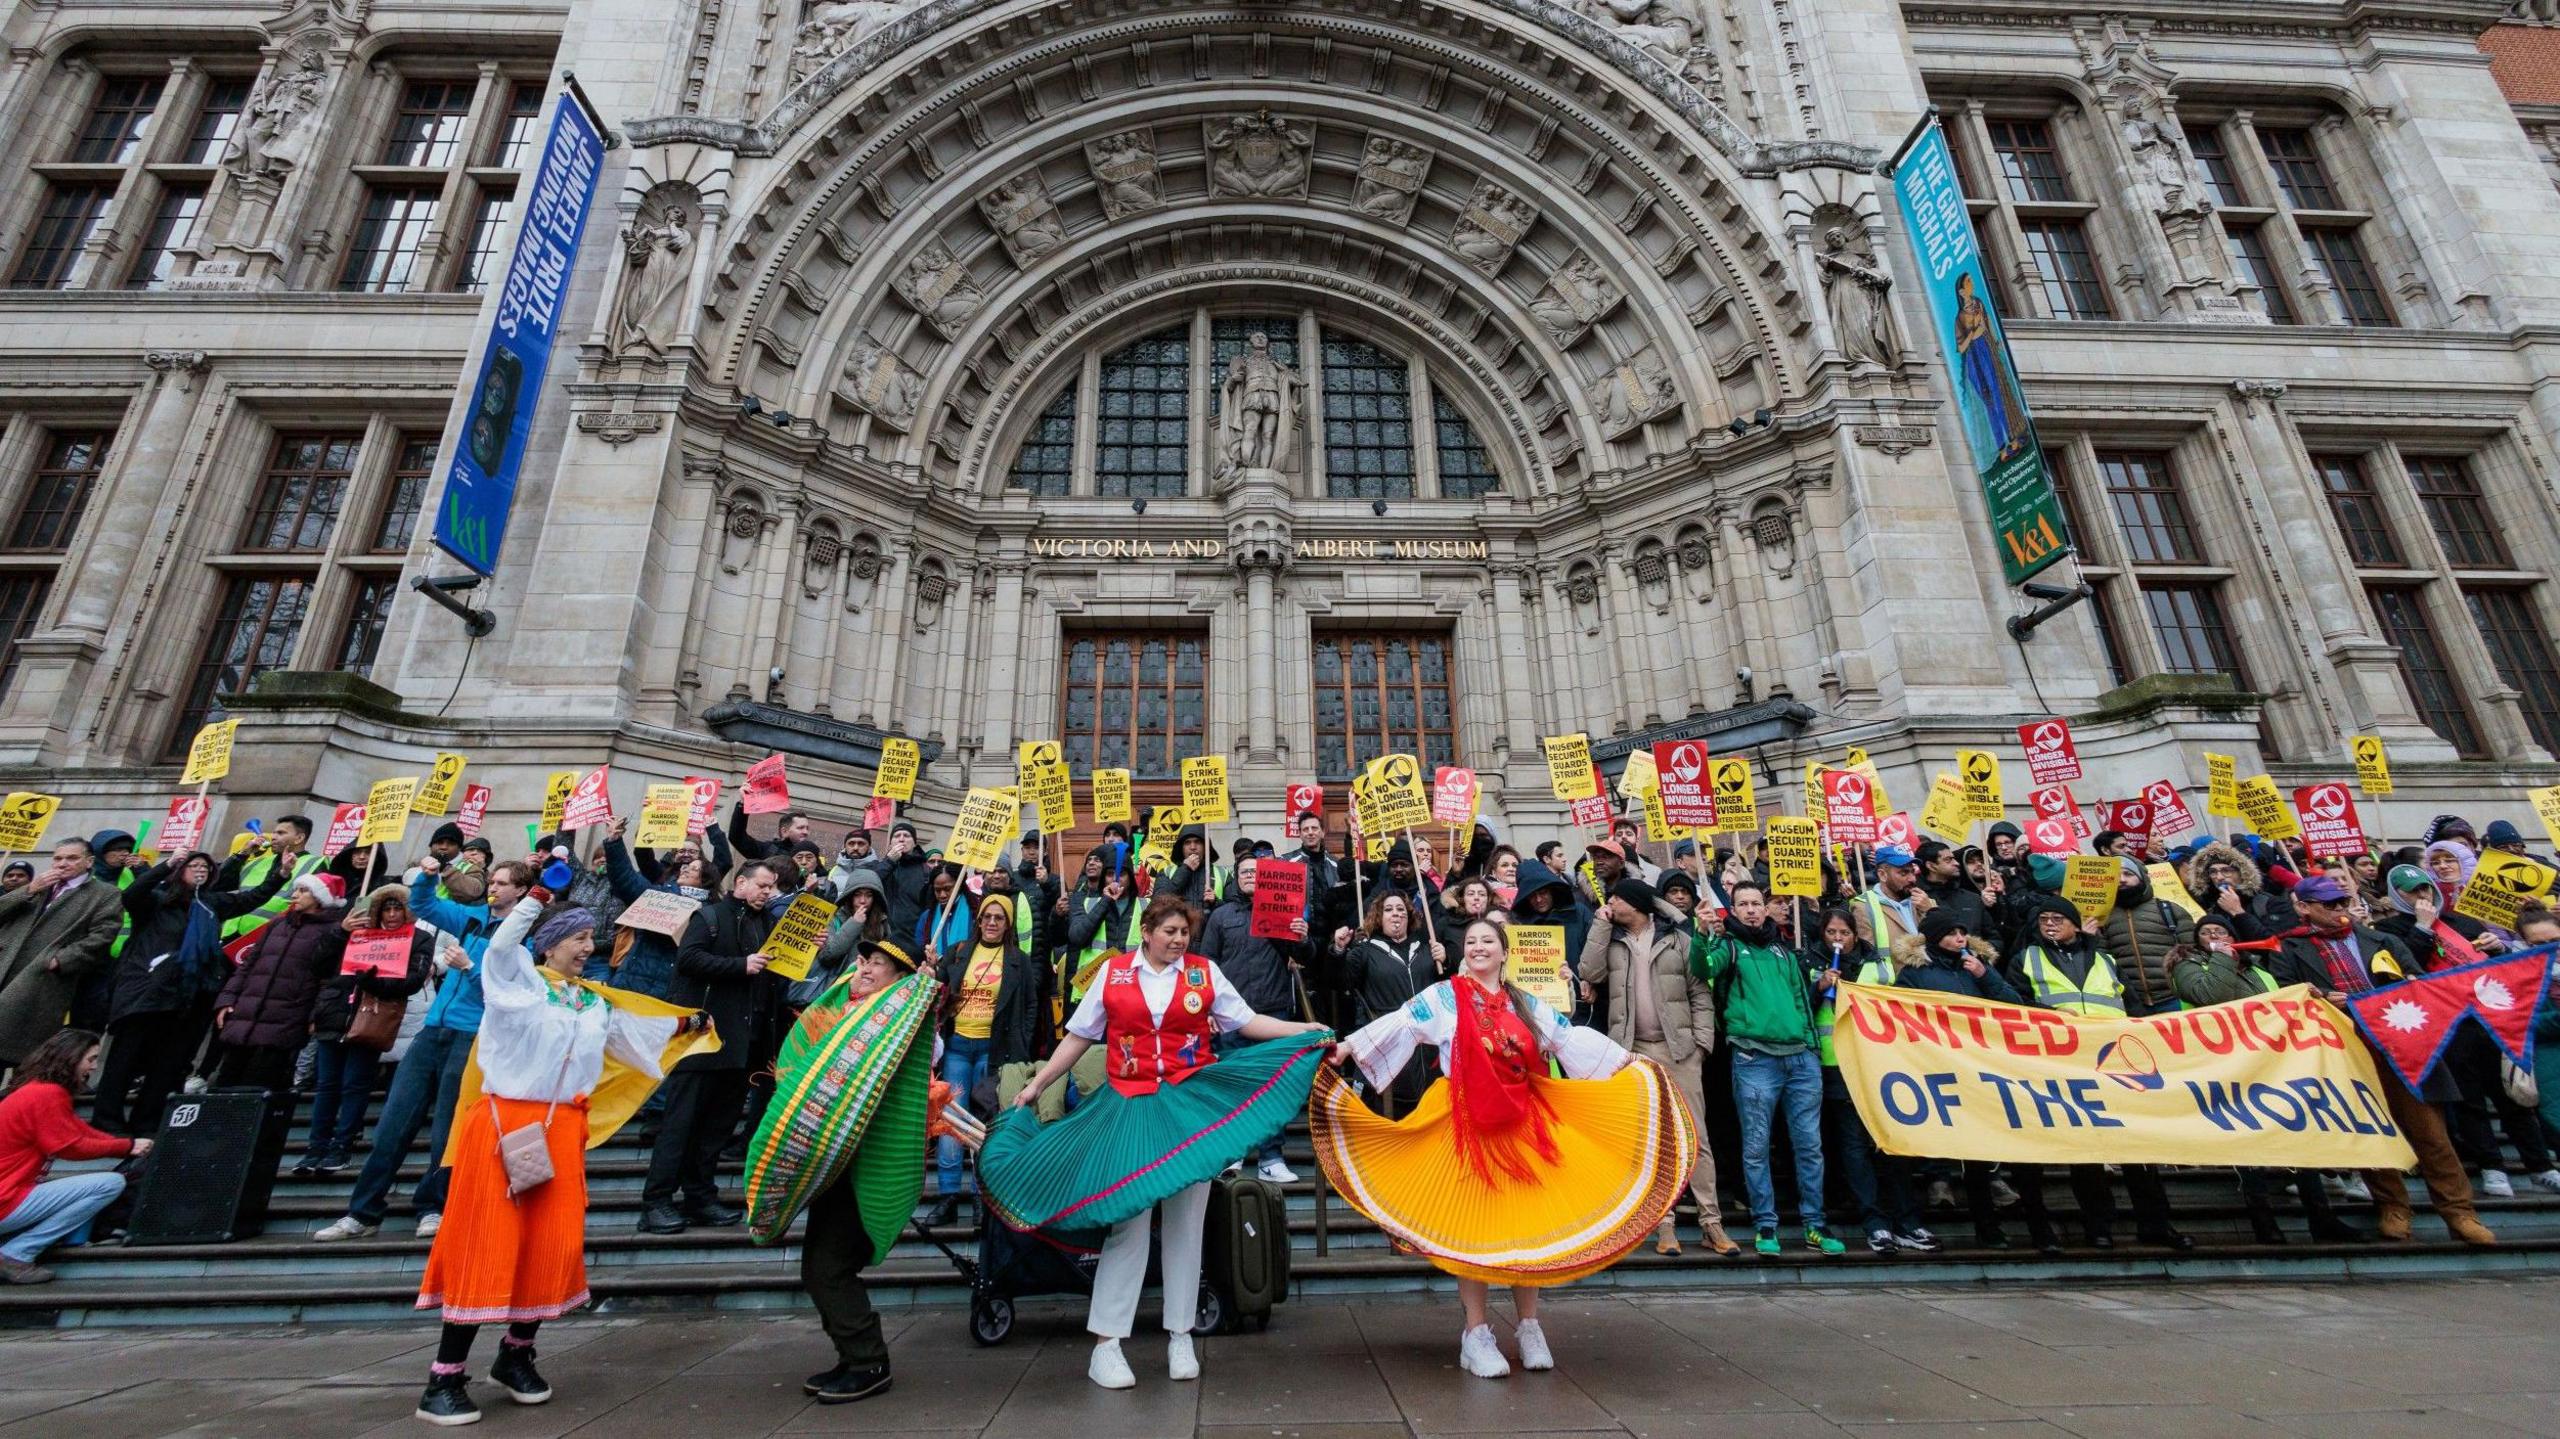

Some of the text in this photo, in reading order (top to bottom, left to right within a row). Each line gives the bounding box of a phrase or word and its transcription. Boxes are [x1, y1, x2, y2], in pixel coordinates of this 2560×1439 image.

[1919, 138, 1973, 265] THE GREAT
[498, 110, 583, 339] MOVING IMAGES
[1903, 167, 1954, 280] MUGHALS
[523, 135, 596, 336] JAMEEL PRIZE
[2003, 511, 2064, 569] V&A
[1032, 539, 1221, 557] VICTORIA AND
[1297, 539, 1487, 558] ALBERT MUSEUM
[895, 740, 908, 749] WE
[1548, 741, 1584, 752] MUSEUM
[886, 748, 914, 758] STRIKE
[1548, 749, 1588, 761] SECURITY
[2026, 747, 2039, 755] NO
[882, 757, 917, 768] BECAUSE
[2030, 751, 2065, 763] LONGER
[1023, 764, 1034, 772] NO
[1196, 759, 1210, 767] WE
[1553, 760, 1588, 769] GUARDS
[2032, 757, 2077, 770] INVISIBLE
[882, 766, 911, 775] YOU'RE
[1188, 768, 1219, 778] STRIKE
[1554, 768, 1588, 779] STRIKE!
[882, 775, 908, 784] TIGHT!
[1098, 777, 1124, 785] STRIKE
[1185, 777, 1224, 788] BECAUSE
[1661, 772, 1676, 782] NO
[373, 784, 412, 795] MUSEUM
[1095, 784, 1127, 793] BECAUSE
[1375, 784, 1389, 794] NO
[1663, 784, 1701, 795] LONGER
[1807, 781, 1815, 789] NO
[2240, 781, 2255, 789] WE
[1099, 792, 1124, 800] YOU'RE
[1189, 787, 1219, 797] YOU'RE
[1377, 789, 1414, 804] LONGER
[2236, 787, 2268, 800] STRIKE
[369, 793, 412, 805] SECURITY
[968, 795, 1012, 812] MUSEUM
[1100, 800, 1123, 809] TIGHT!
[1191, 797, 1219, 807] TIGHT!
[1715, 795, 1743, 804] ONGER
[1828, 796, 1841, 804] NO
[2237, 795, 2278, 810] BECAUSE
[1380, 797, 1425, 813] INVISIBLE
[1830, 806, 1863, 815] LONGER
[2, 810, 16, 819] NO
[962, 805, 1012, 825] SECURITY
[1381, 809, 1426, 823] UNITED VOICES
[2245, 805, 2278, 818] YOU'RE
[2301, 812, 2317, 822] NO
[961, 816, 1003, 834] GUARDS
[1406, 816, 1428, 826] WORLD
[1831, 815, 1875, 825] INVISIBLE
[2305, 820, 2347, 831] LONGER
[1770, 824, 1814, 835] MUSEUM
[2308, 828, 2360, 841] INVISIBLE
[957, 827, 998, 846] STRIKE!
[1768, 835, 1817, 846] SECURITY
[1773, 847, 1815, 858] GUARDS
[1773, 858, 1814, 870] STRIKE!
[2079, 860, 2110, 868] HARRODS
[1260, 870, 1303, 883] HARRODS
[2475, 872, 2494, 882] NO
[1258, 881, 1304, 893] WORKERS
[1273, 892, 1287, 902] ON
[2075, 890, 2107, 898] HARRODS
[2466, 890, 2520, 914] INVISIBL
[795, 901, 830, 920] MUSEUM
[1261, 902, 1298, 914] STRIKE!
[1517, 931, 1552, 939] HARRODS
[773, 932, 811, 953] STRIKE!
[353, 952, 401, 961] STRIKE!
[1529, 948, 1560, 956] MILLION
[1519, 967, 1555, 975] HARRODS
[961, 989, 992, 998] ONGER
[1849, 993, 2345, 1056] UNITED VOICES
[1879, 1071, 2399, 1138] OF THE WORLD
